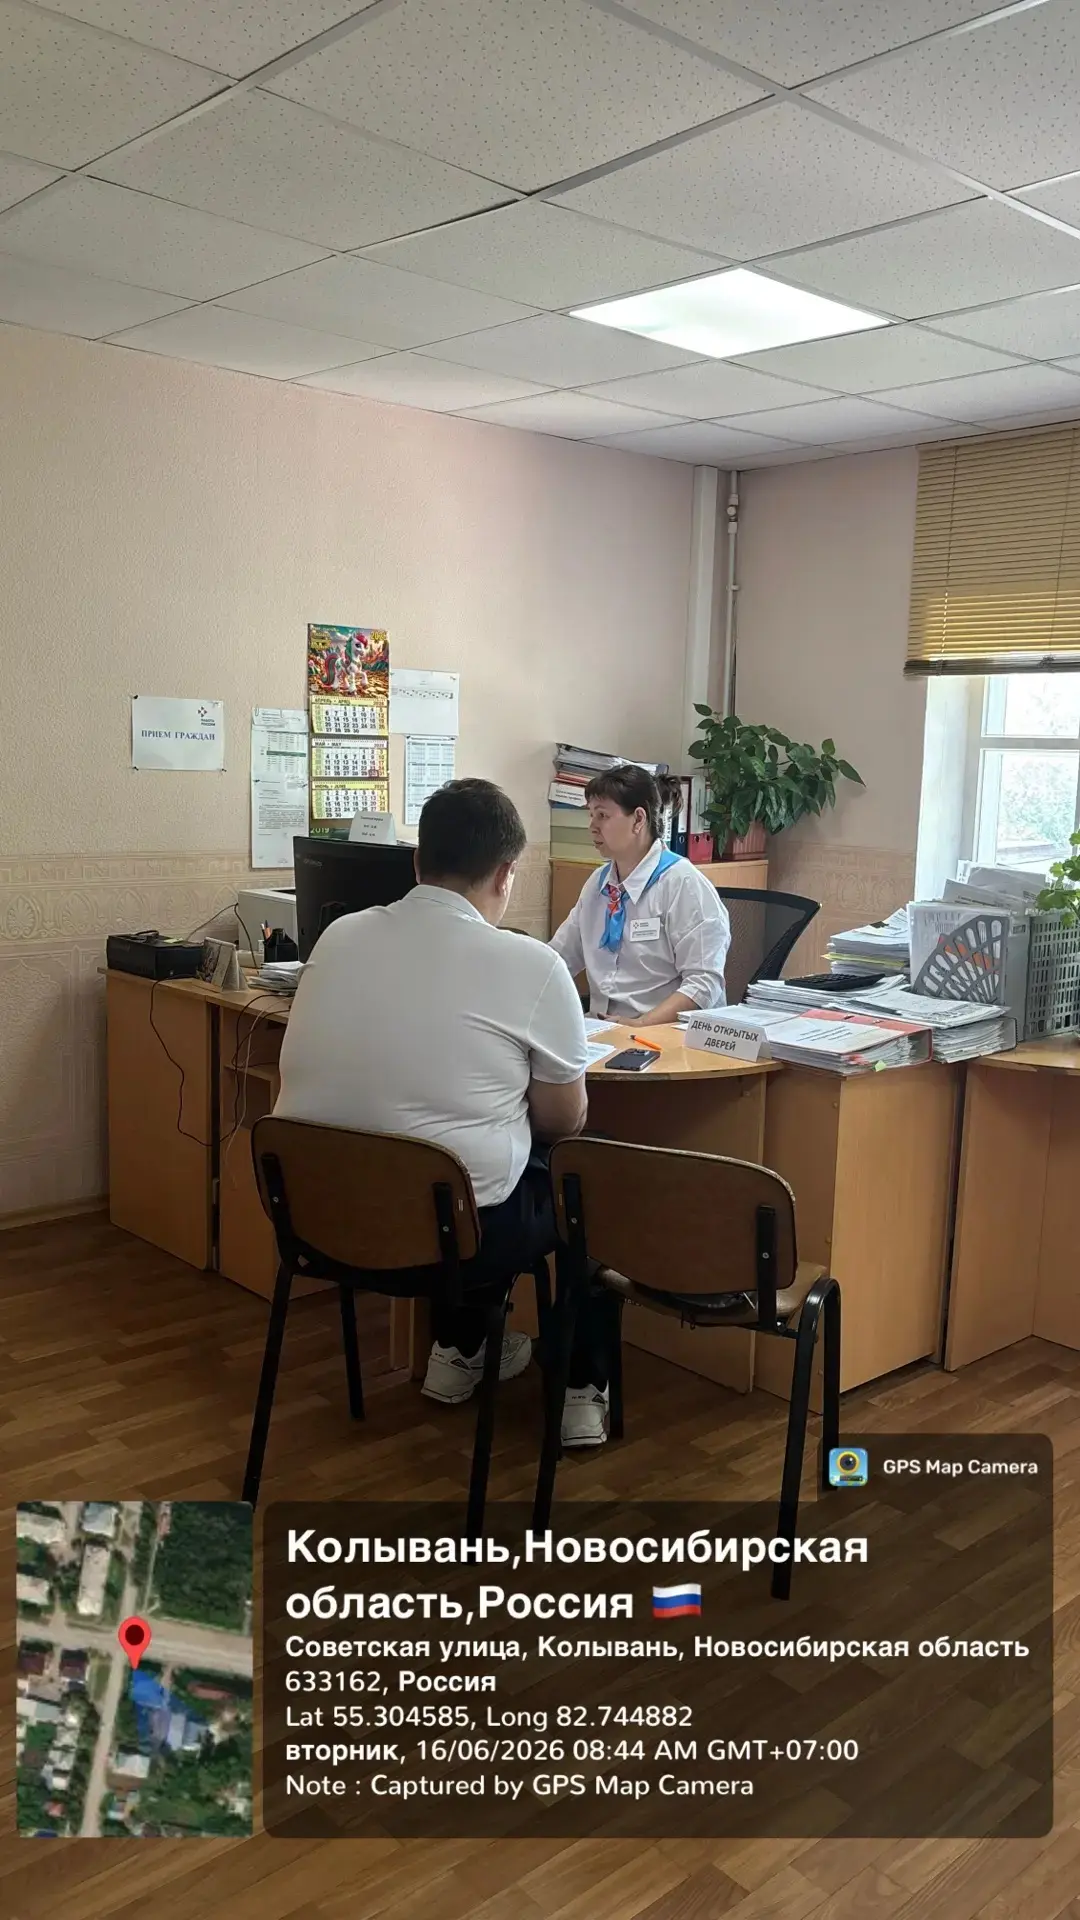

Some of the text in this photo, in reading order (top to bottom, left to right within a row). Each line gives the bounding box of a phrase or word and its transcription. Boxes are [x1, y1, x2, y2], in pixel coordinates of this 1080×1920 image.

[141, 730, 215, 741] ПРИЕМ ГРАЖДАН
[691, 1020, 758, 1041] ДЕНЬ ОТКРЫТЫХ
[704, 1037, 736, 1051] ДВЕРЕЙ
